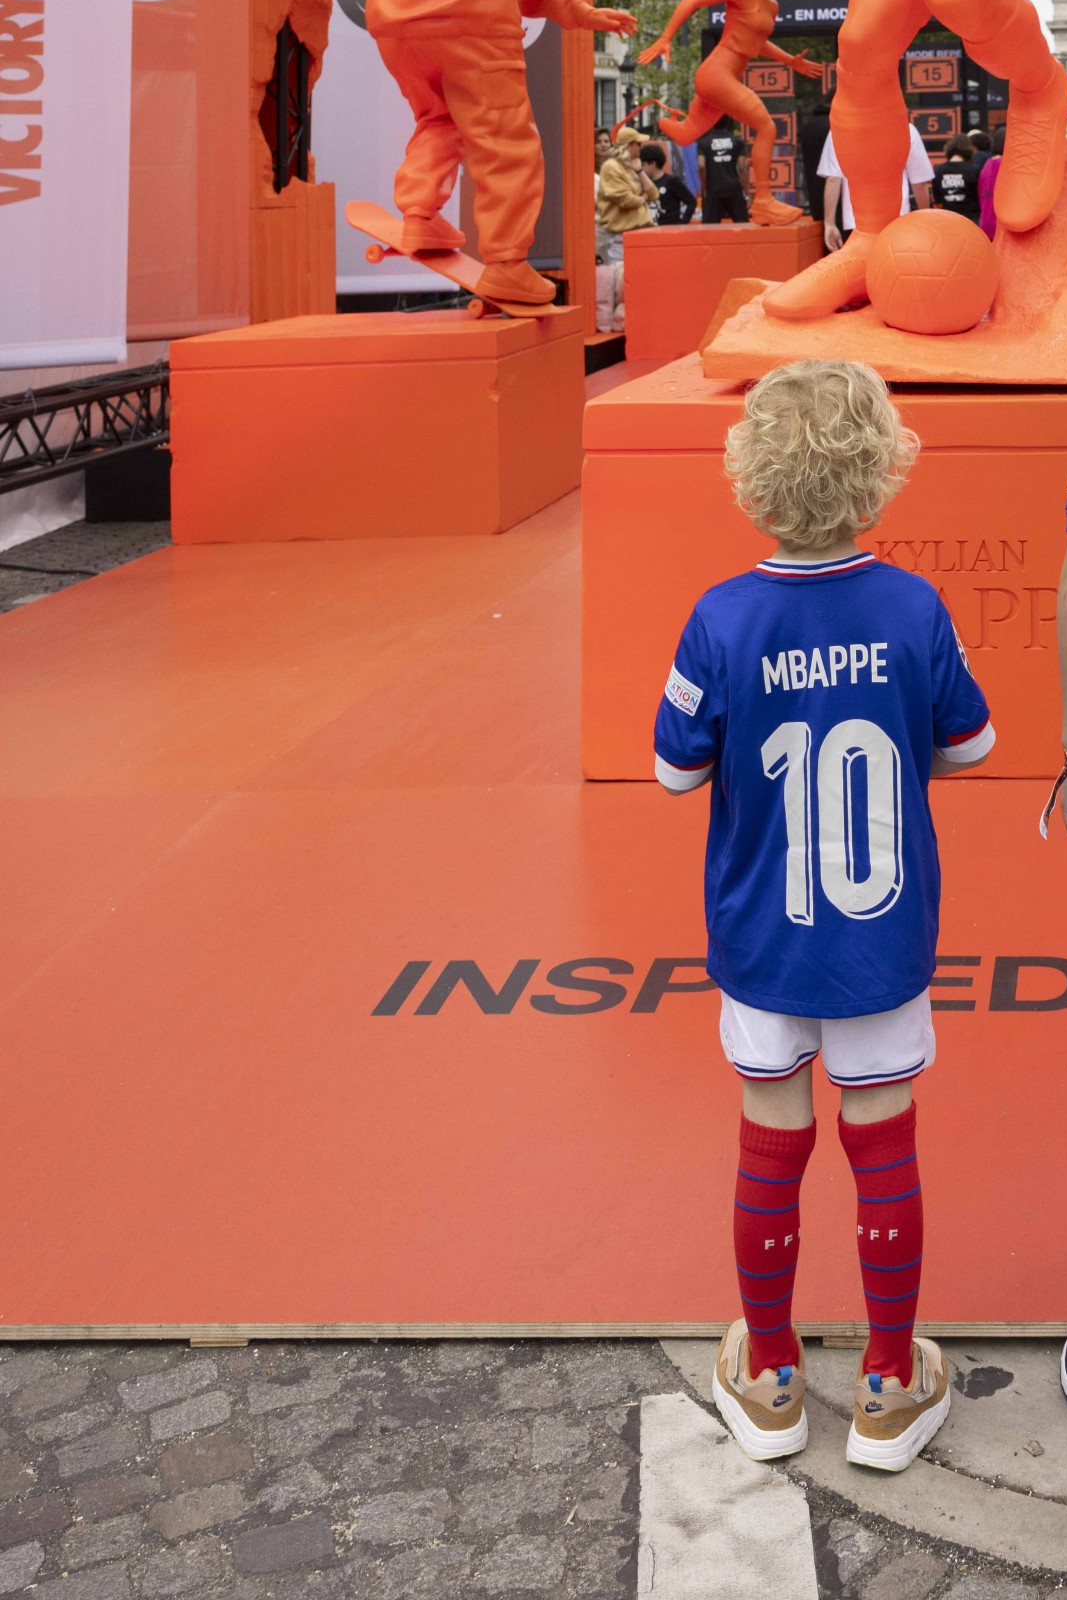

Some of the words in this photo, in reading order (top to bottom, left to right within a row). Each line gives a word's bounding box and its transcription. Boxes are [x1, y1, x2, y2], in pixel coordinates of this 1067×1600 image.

[794, 9, 814, 21] EN
[816, 7, 849, 20] MOD
[758, 71, 778, 87] 15
[922, 67, 942, 82] 15
[928, 118, 940, 132] 5
[876, 539, 1028, 572] KYLIAN
[761, 642, 888, 694] MBAPPE
[670, 682, 699, 708] ATION
[760, 719, 904, 926] 10
